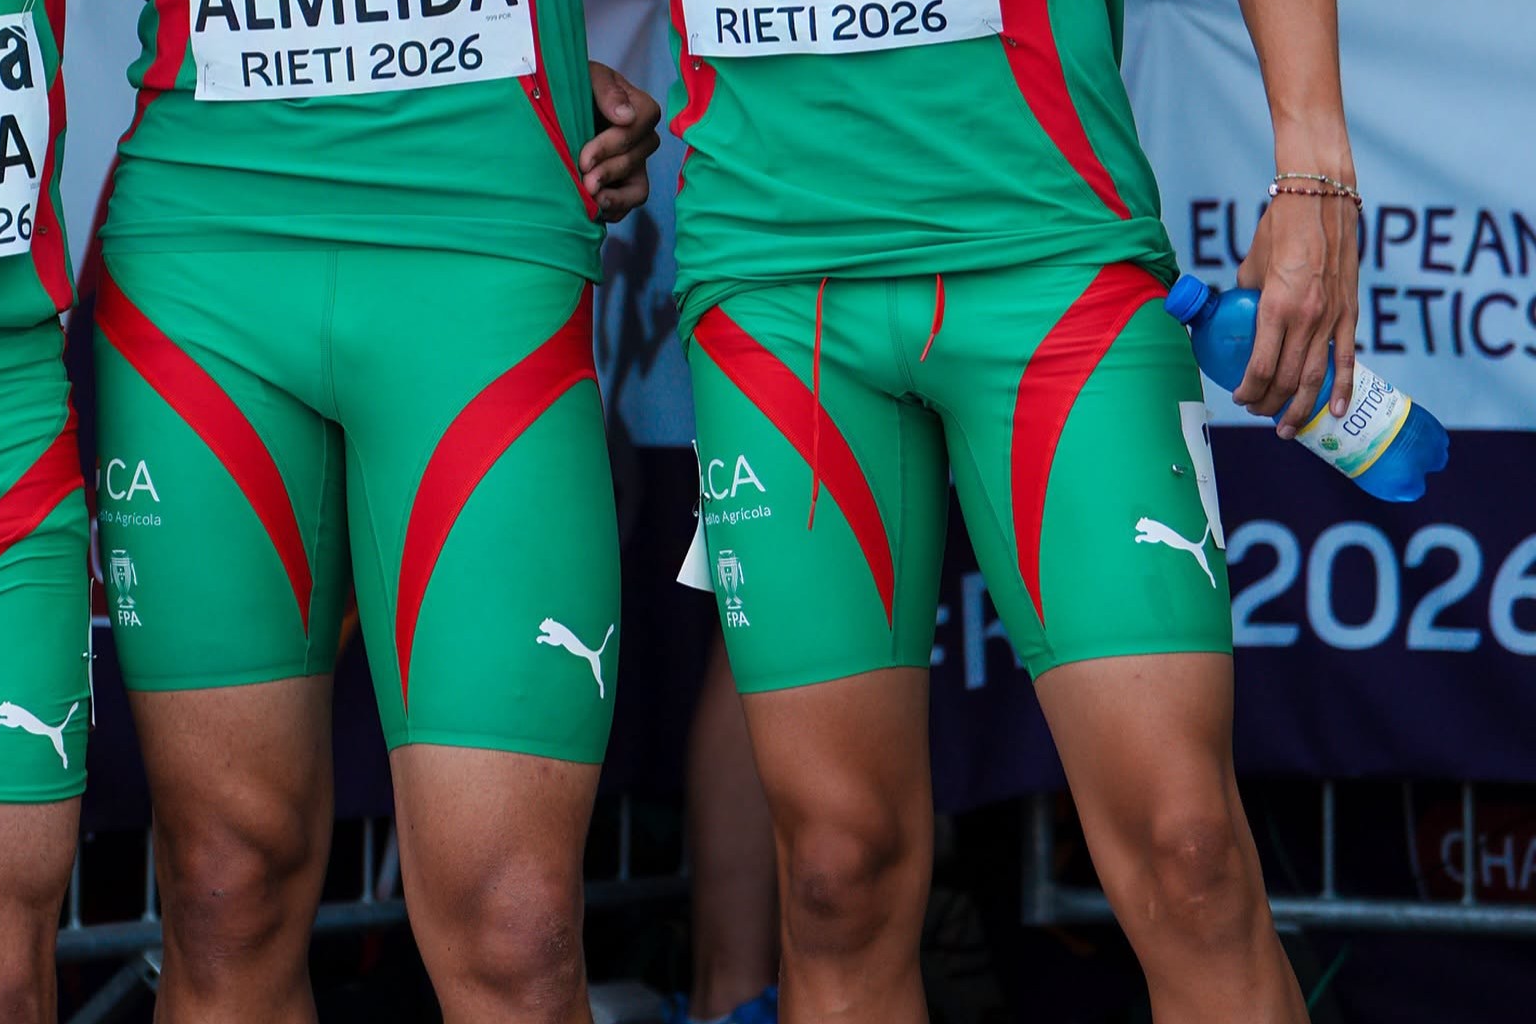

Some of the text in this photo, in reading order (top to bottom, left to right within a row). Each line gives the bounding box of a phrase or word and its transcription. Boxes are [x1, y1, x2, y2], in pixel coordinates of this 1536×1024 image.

[716, 0, 947, 44] RIETI 2026
[241, 33, 483, 87] RIETI 2026
[106, 458, 160, 502] CA
[708, 455, 766, 500] CA
[115, 511, 161, 526] Agrícola
[722, 505, 771, 525] Agrícola
[1225, 519, 1536, 656] 2026
[118, 610, 142, 626] FPA
[727, 611, 750, 627] FPA
